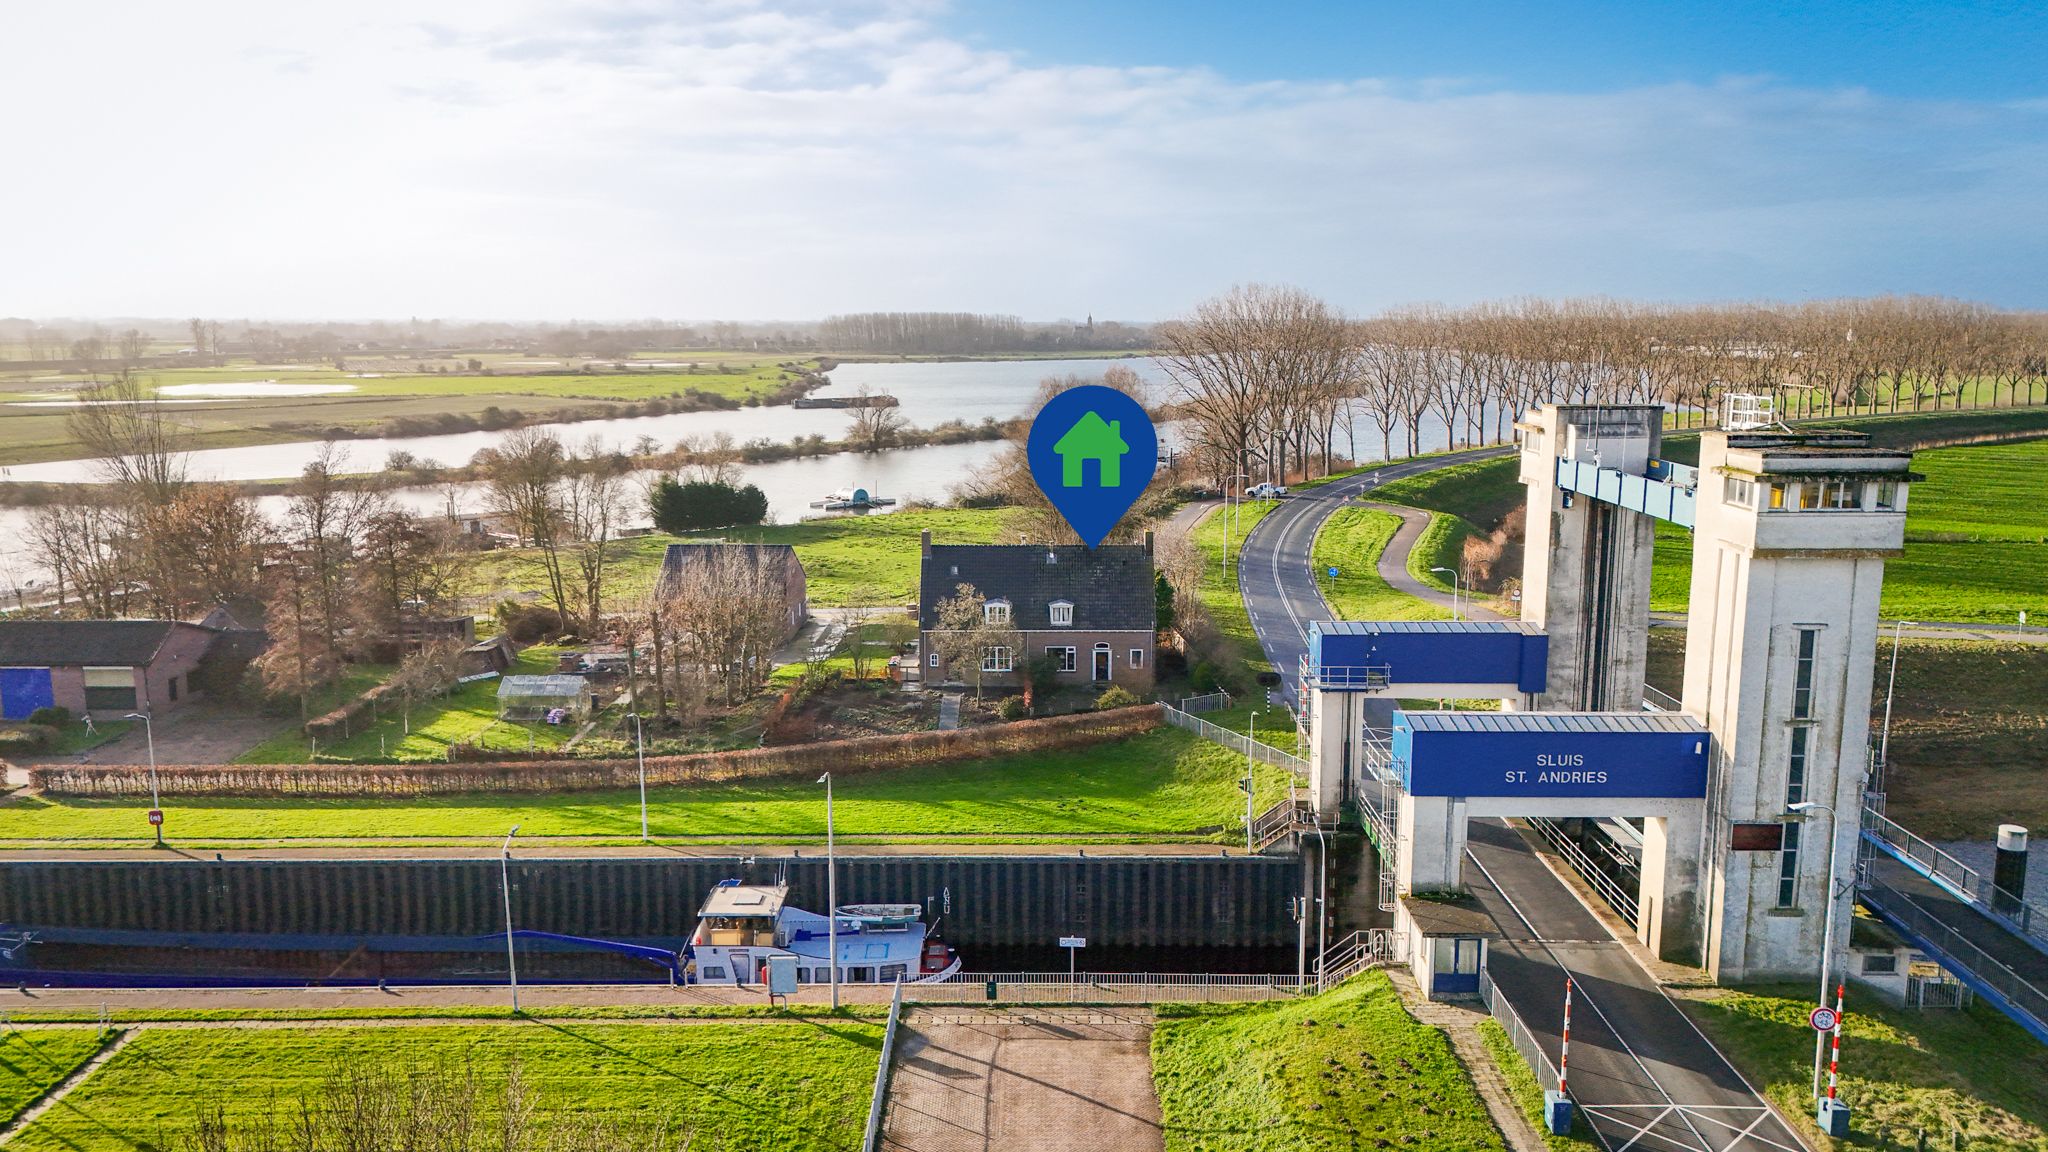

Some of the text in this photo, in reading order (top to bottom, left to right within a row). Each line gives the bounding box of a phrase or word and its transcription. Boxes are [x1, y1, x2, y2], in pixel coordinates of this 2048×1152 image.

[1536, 754, 1584, 767] SLUIS
[1505, 771, 1608, 784] ST. ANDRIES
